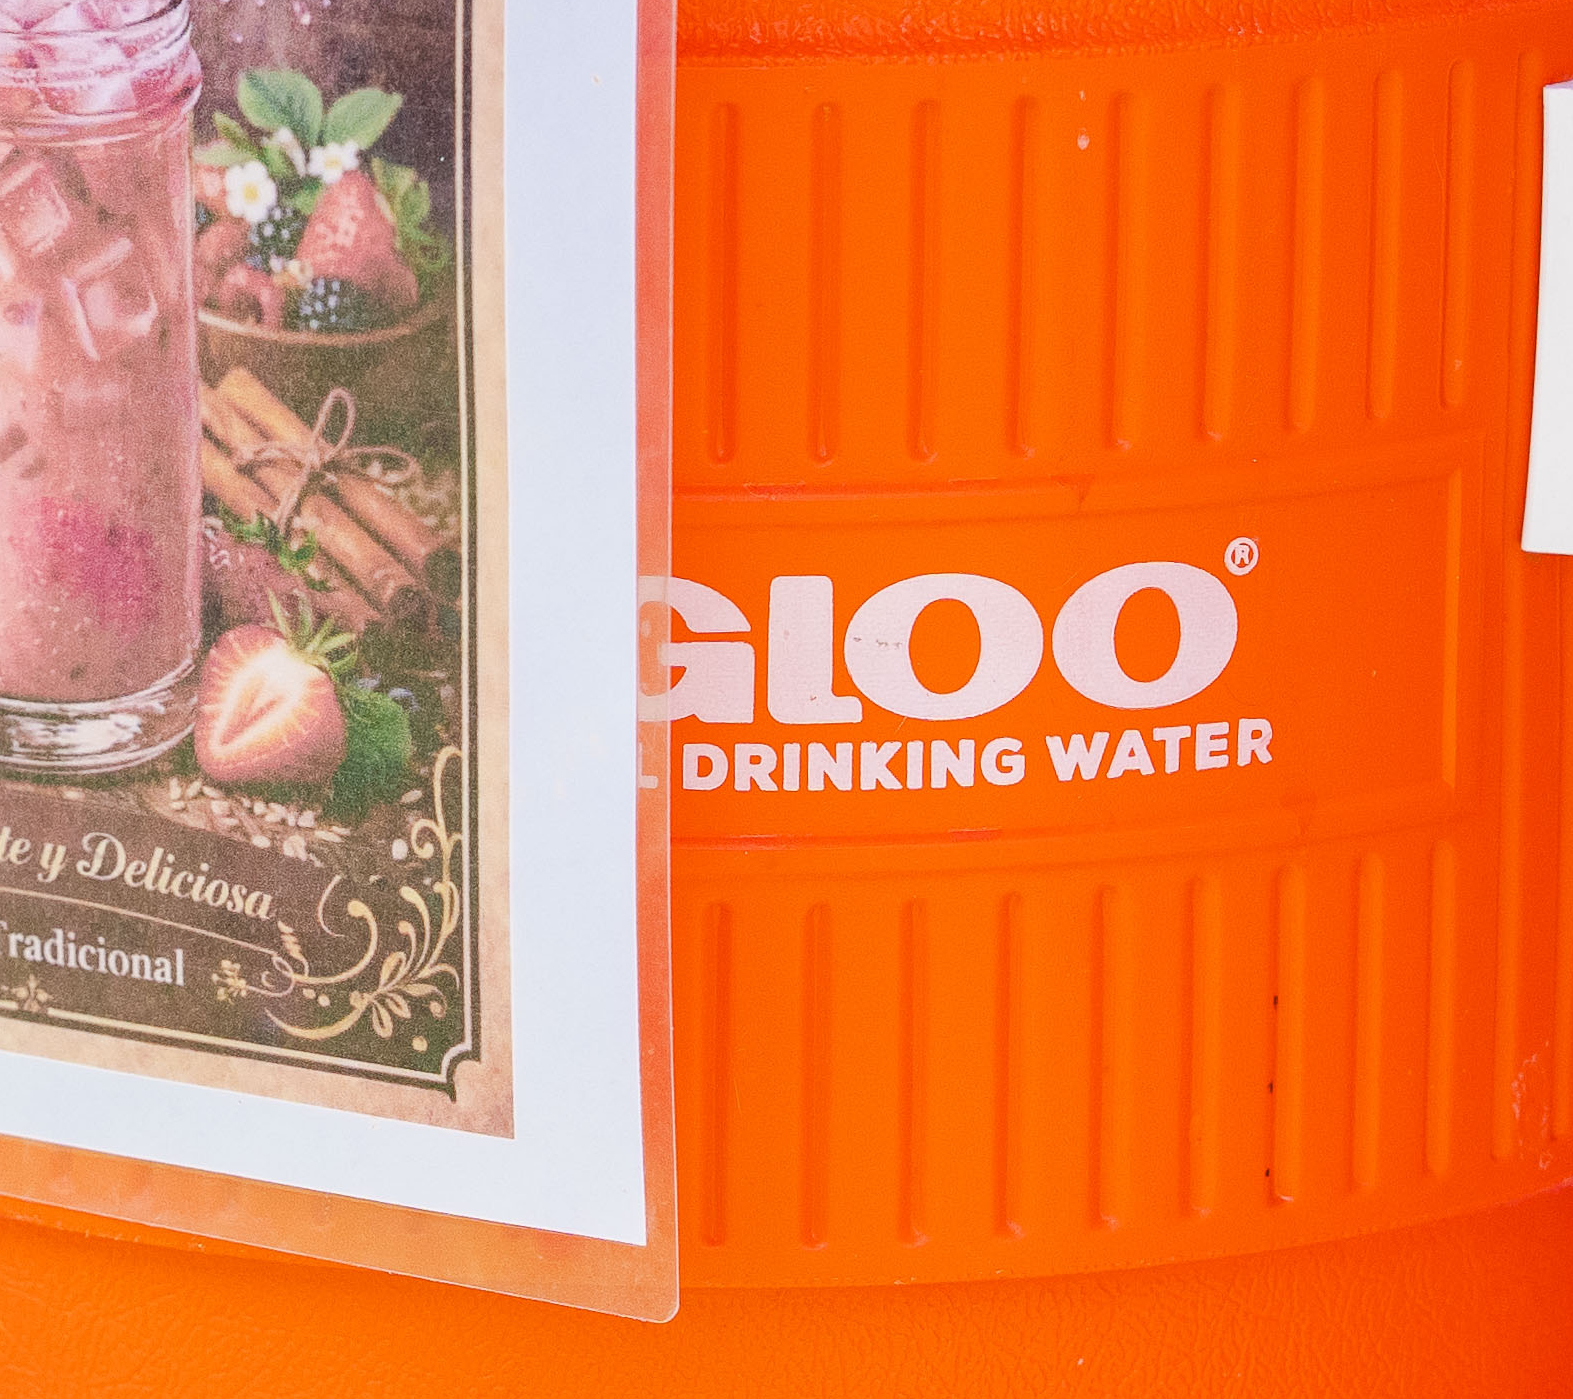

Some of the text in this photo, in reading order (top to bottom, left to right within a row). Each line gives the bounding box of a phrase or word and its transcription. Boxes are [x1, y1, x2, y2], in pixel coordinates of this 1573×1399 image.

[682, 737, 1026, 793] DRINKING
[1046, 718, 1274, 783] WATER
[37, 841, 67, 883] y
[76, 831, 274, 920] Deliciosa
